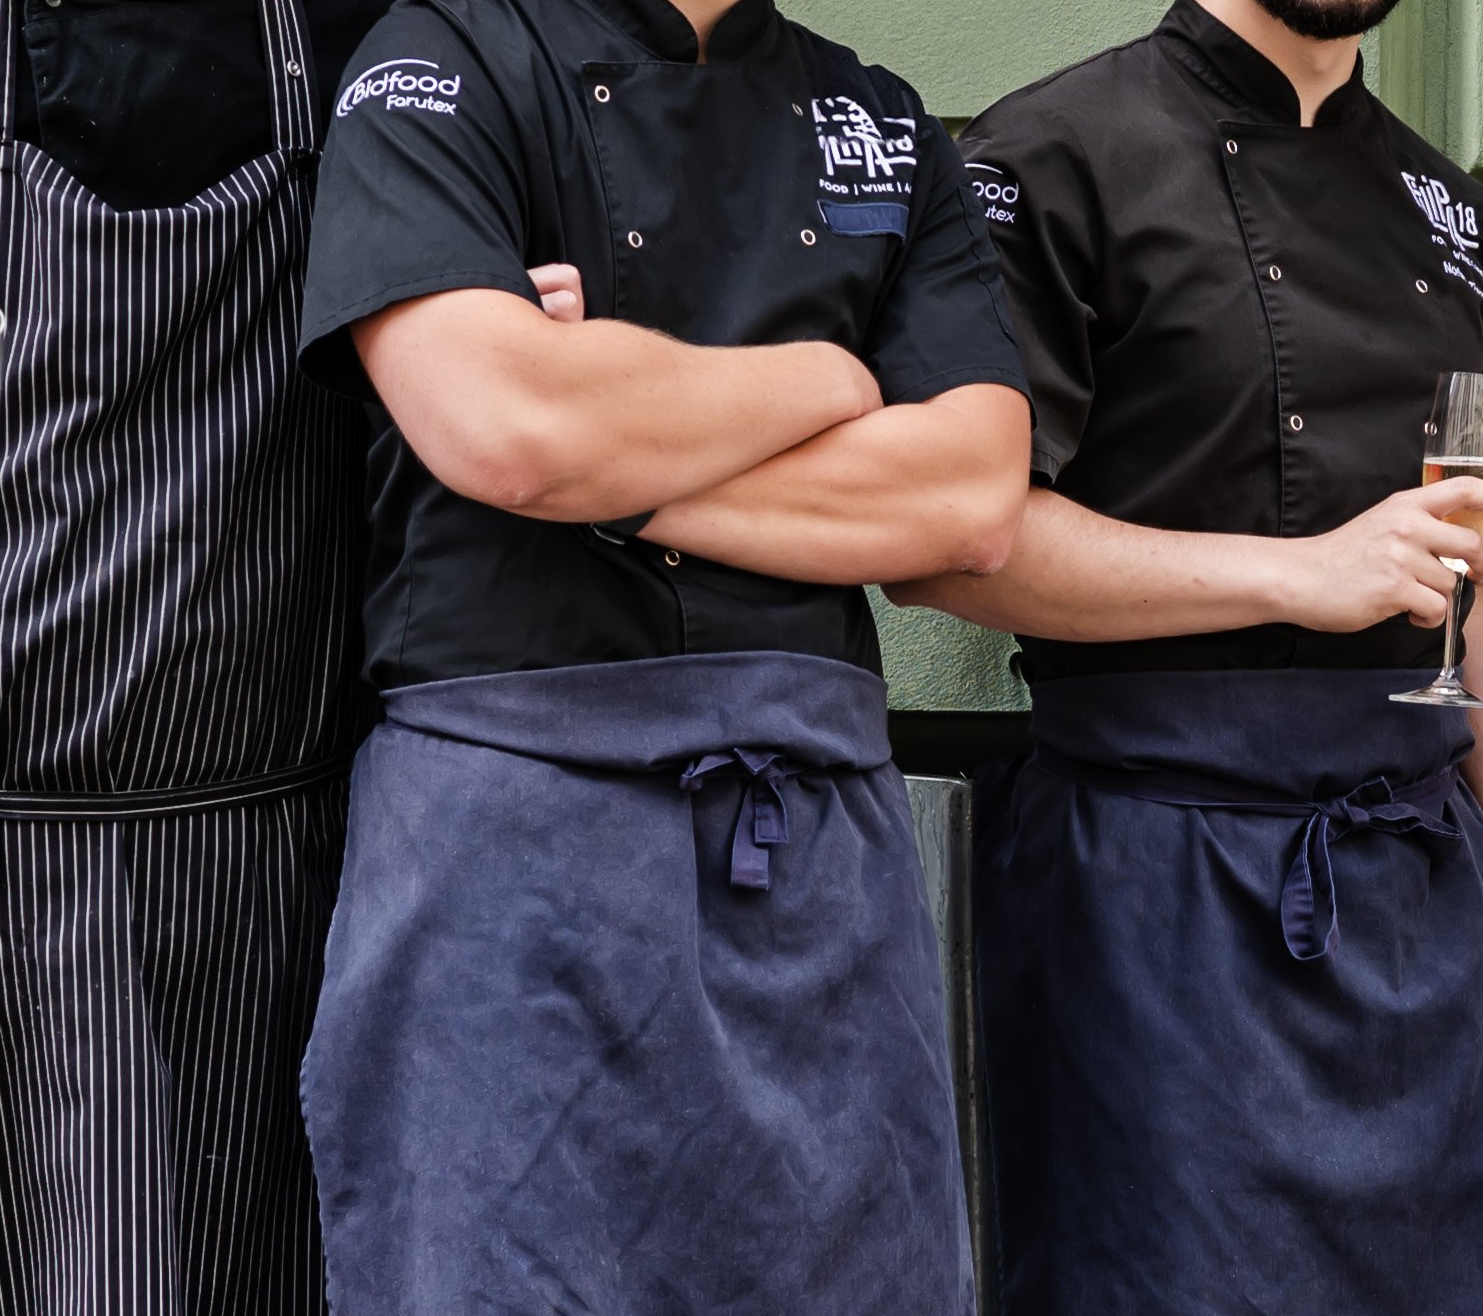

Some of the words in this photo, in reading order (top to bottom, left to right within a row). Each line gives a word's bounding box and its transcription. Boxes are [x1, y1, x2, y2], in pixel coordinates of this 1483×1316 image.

[386, 94, 456, 116] Farutex
[819, 178, 849, 194] FOOD
[861, 183, 895, 194] WINE
[1455, 201, 1479, 236] 18
